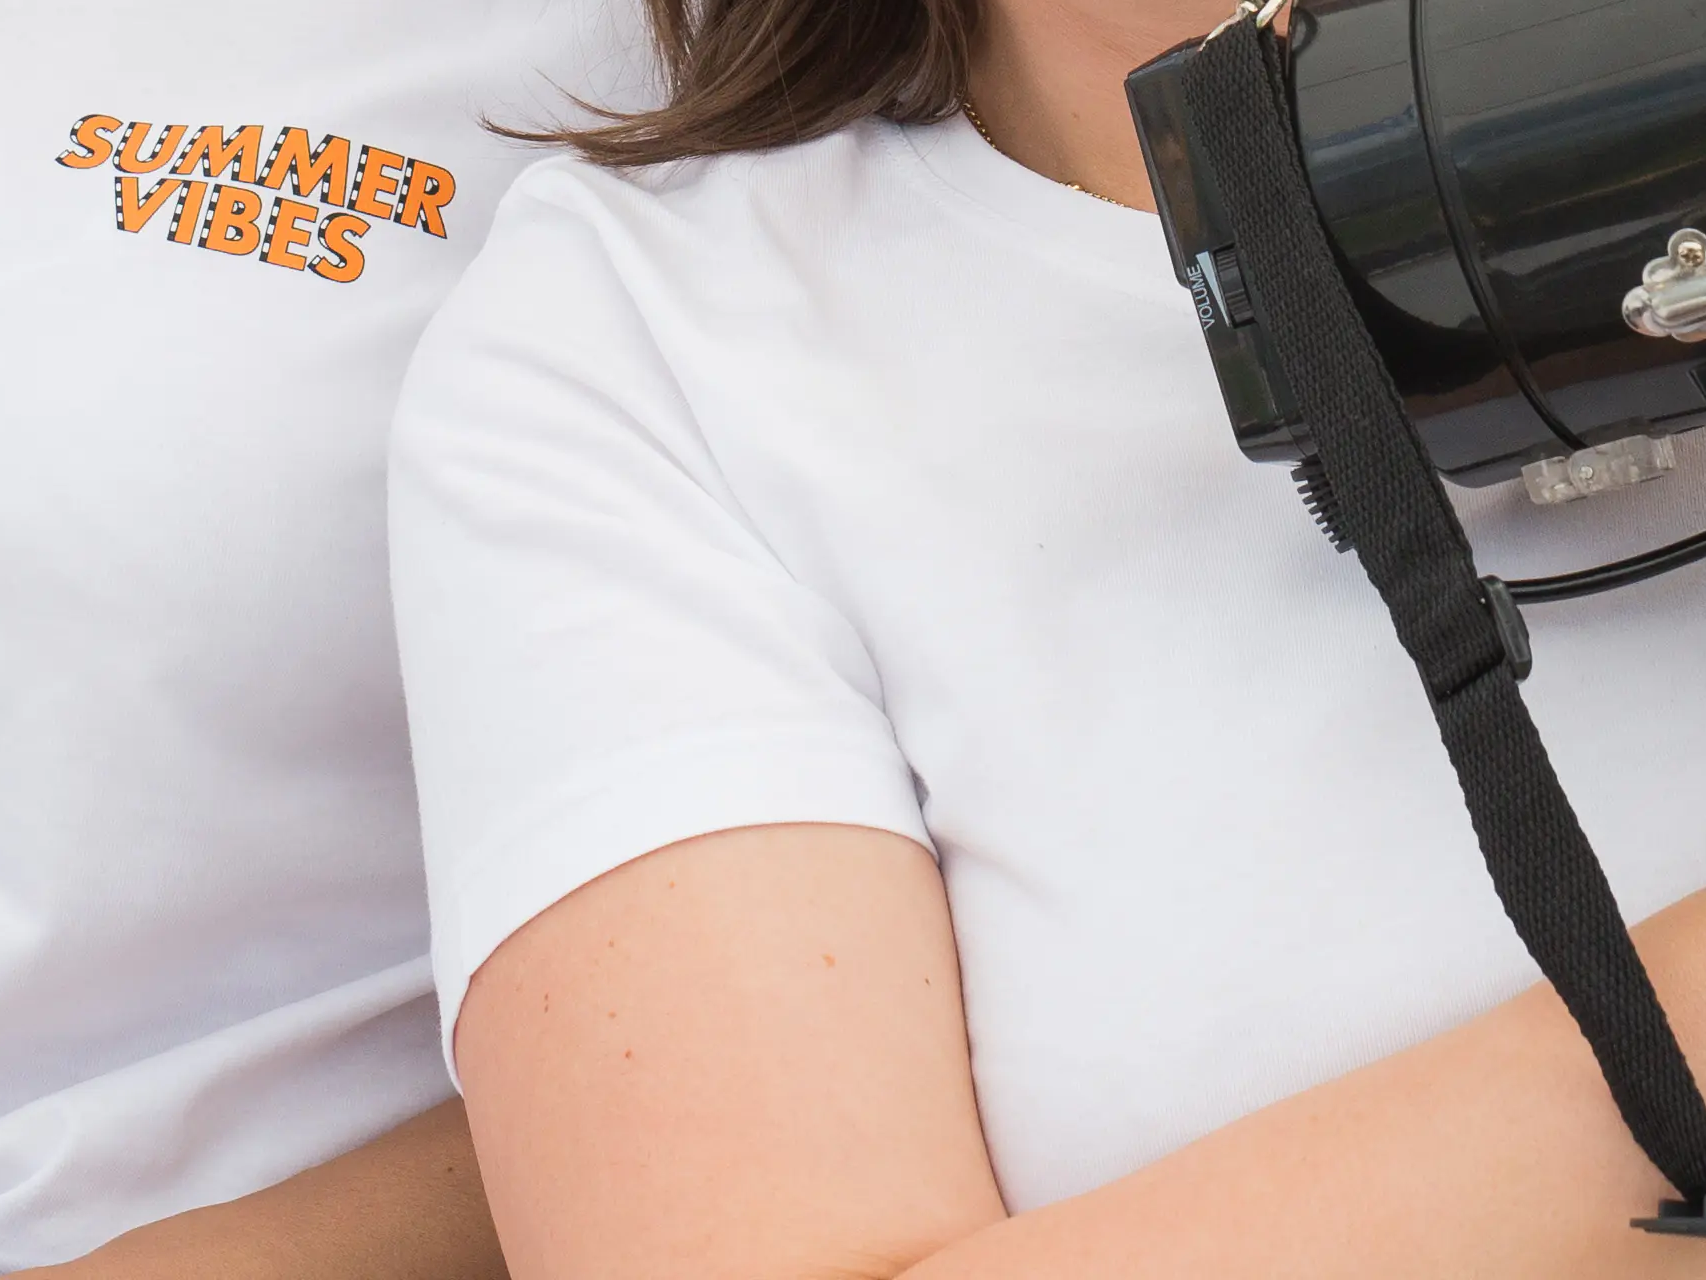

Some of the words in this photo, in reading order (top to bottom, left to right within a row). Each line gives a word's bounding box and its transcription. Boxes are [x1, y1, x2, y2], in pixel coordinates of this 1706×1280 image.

[55, 114, 456, 239] SUMMER
[114, 176, 372, 283] VIBES
[1187, 264, 1215, 330] VOLUME
